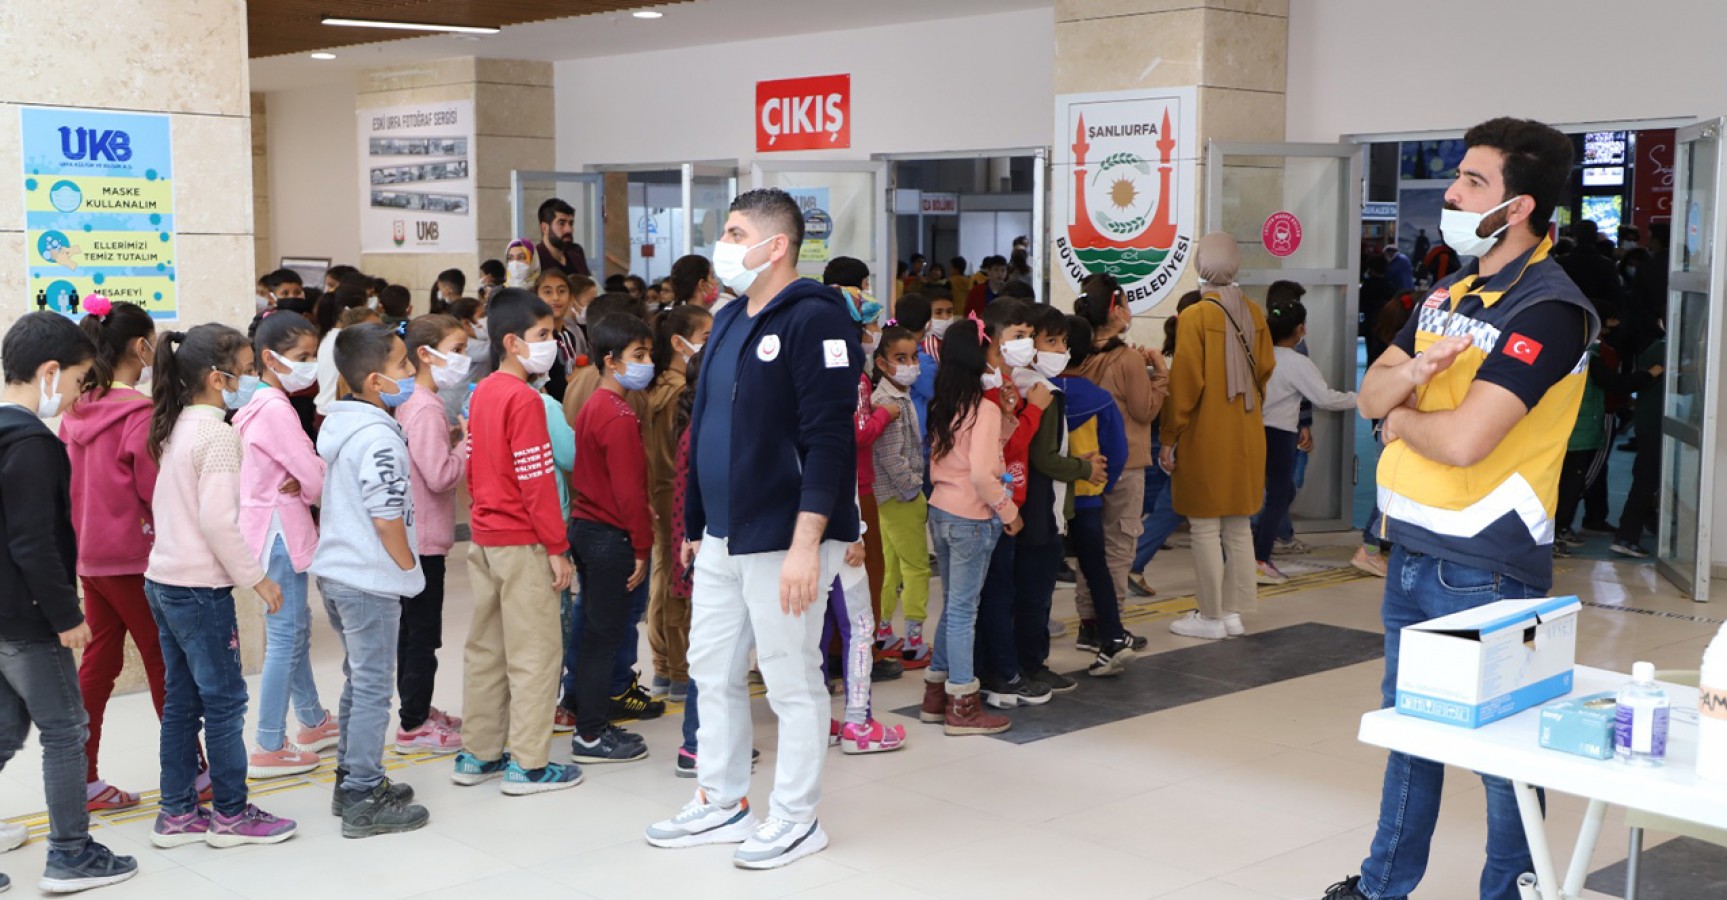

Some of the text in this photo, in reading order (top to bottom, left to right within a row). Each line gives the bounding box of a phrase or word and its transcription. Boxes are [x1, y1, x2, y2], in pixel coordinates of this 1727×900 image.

[762, 93, 843, 145] ÇIKIŞ
[1088, 123, 1158, 139] ŞANLIURFA
[58, 126, 133, 162] UKB
[102, 187, 141, 196] MASKE
[86, 199, 157, 209] KULLANALIM
[416, 221, 439, 240] UKB
[94, 241, 148, 250] ELLERİMİZİ
[84, 252, 158, 261] TEMİZ TUTALIM
[1127, 235, 1190, 302] BELEDİYESİ
